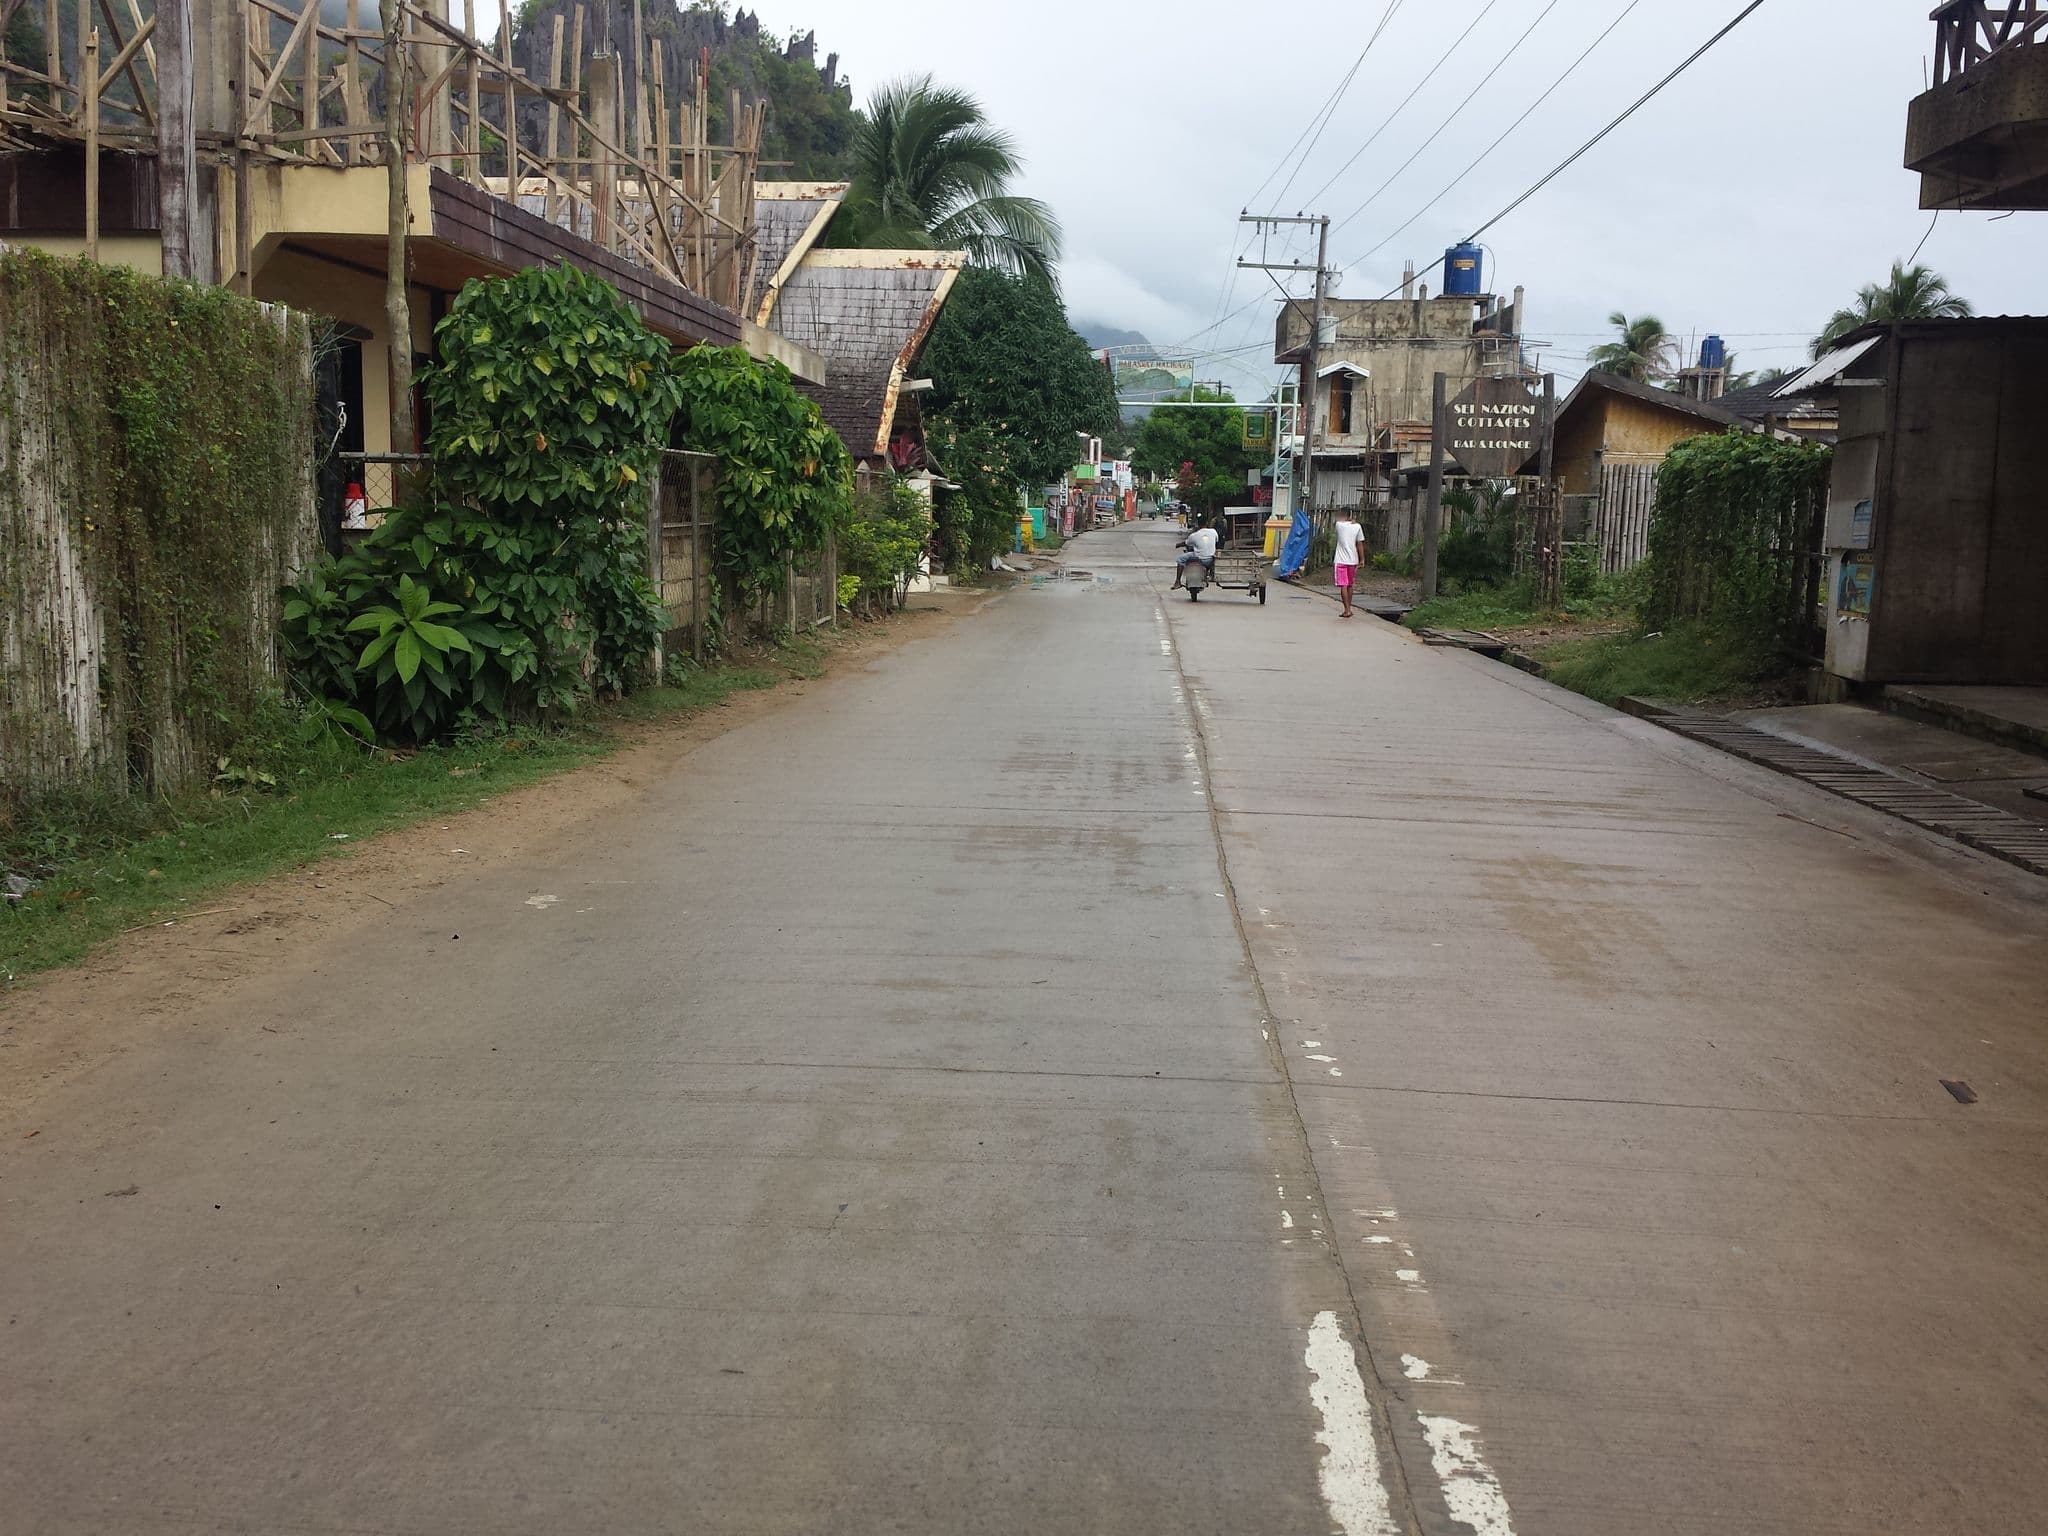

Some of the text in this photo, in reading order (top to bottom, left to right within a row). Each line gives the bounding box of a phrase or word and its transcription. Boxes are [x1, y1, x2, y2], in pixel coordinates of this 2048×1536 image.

[1454, 404, 1536, 415] SEI NAZIONI
[1457, 417, 1531, 428] COTTAGES
[1454, 440, 1532, 449] BAR & LOUNGE
